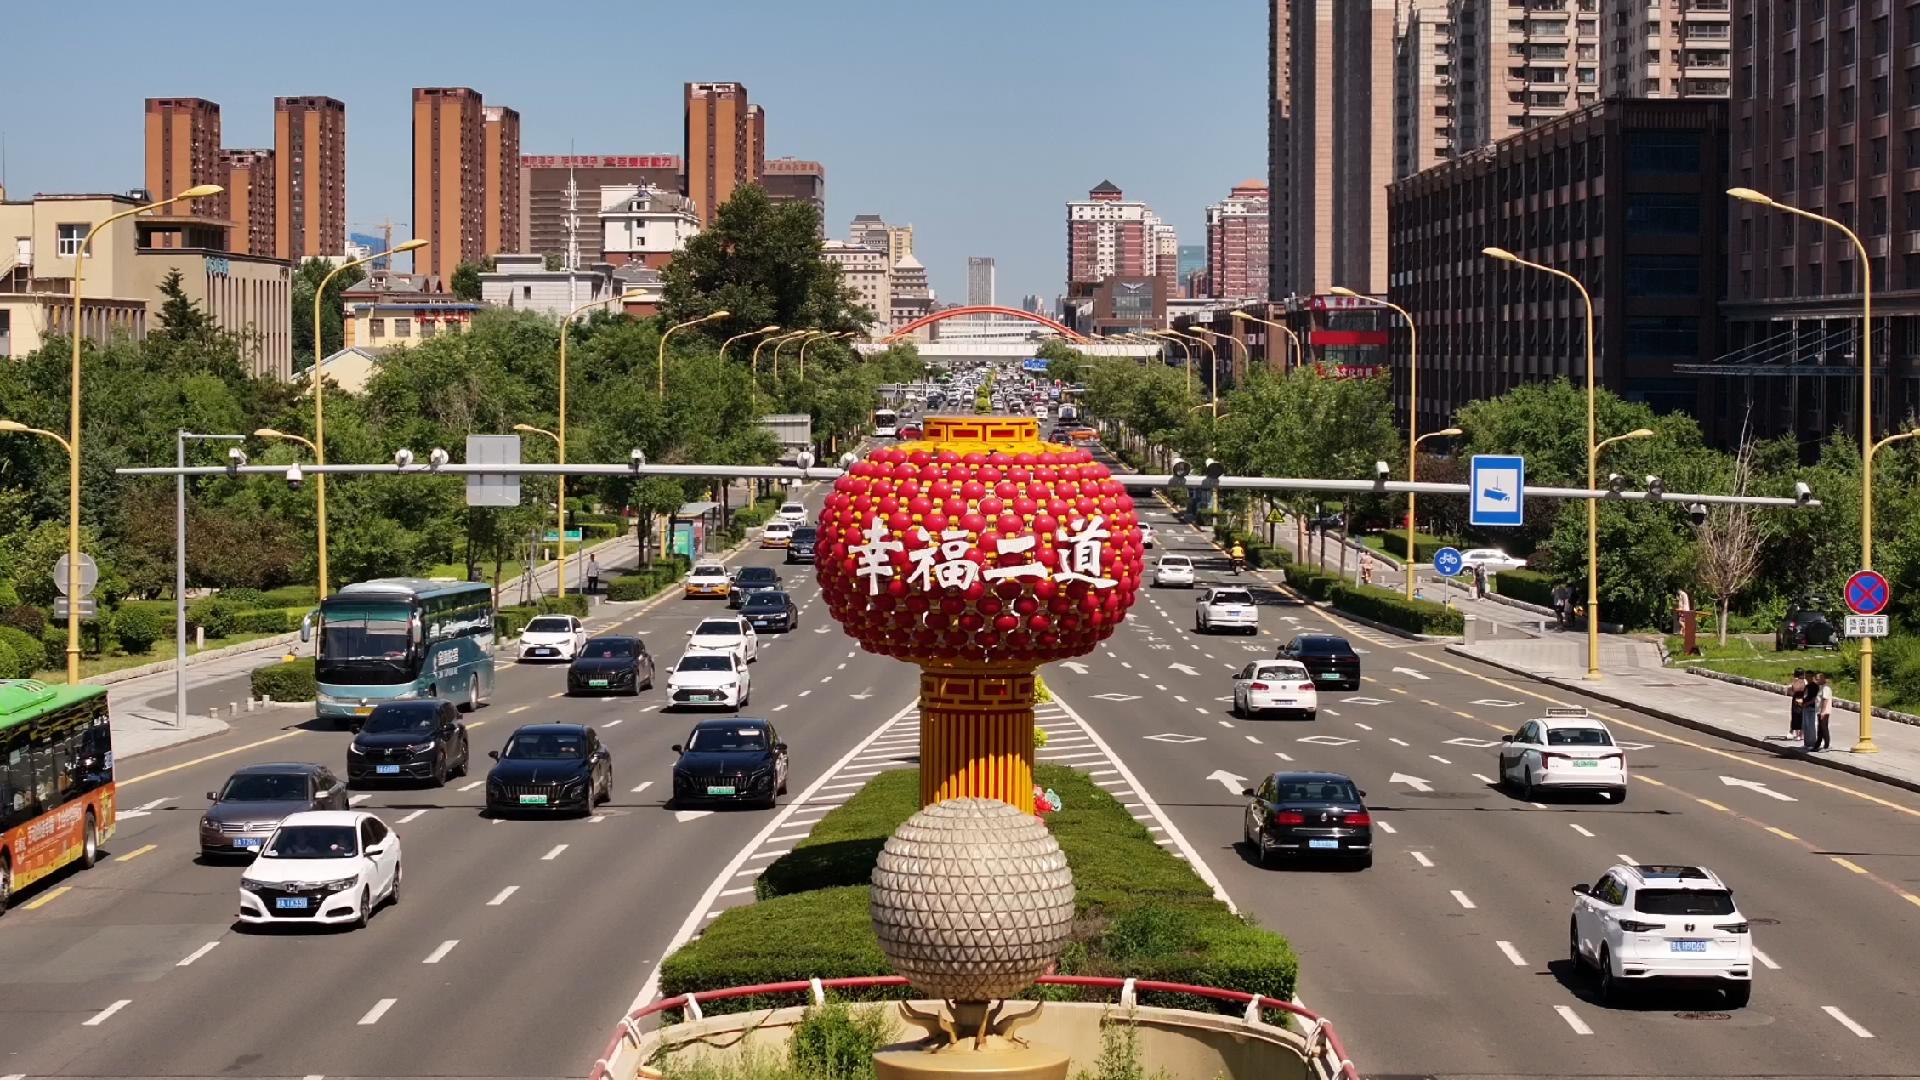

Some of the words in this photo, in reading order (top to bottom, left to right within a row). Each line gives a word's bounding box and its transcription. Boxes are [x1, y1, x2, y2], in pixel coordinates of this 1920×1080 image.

[848, 515, 1118, 595] 幸福二道
[1850, 618, 1883, 626] 违法停车
